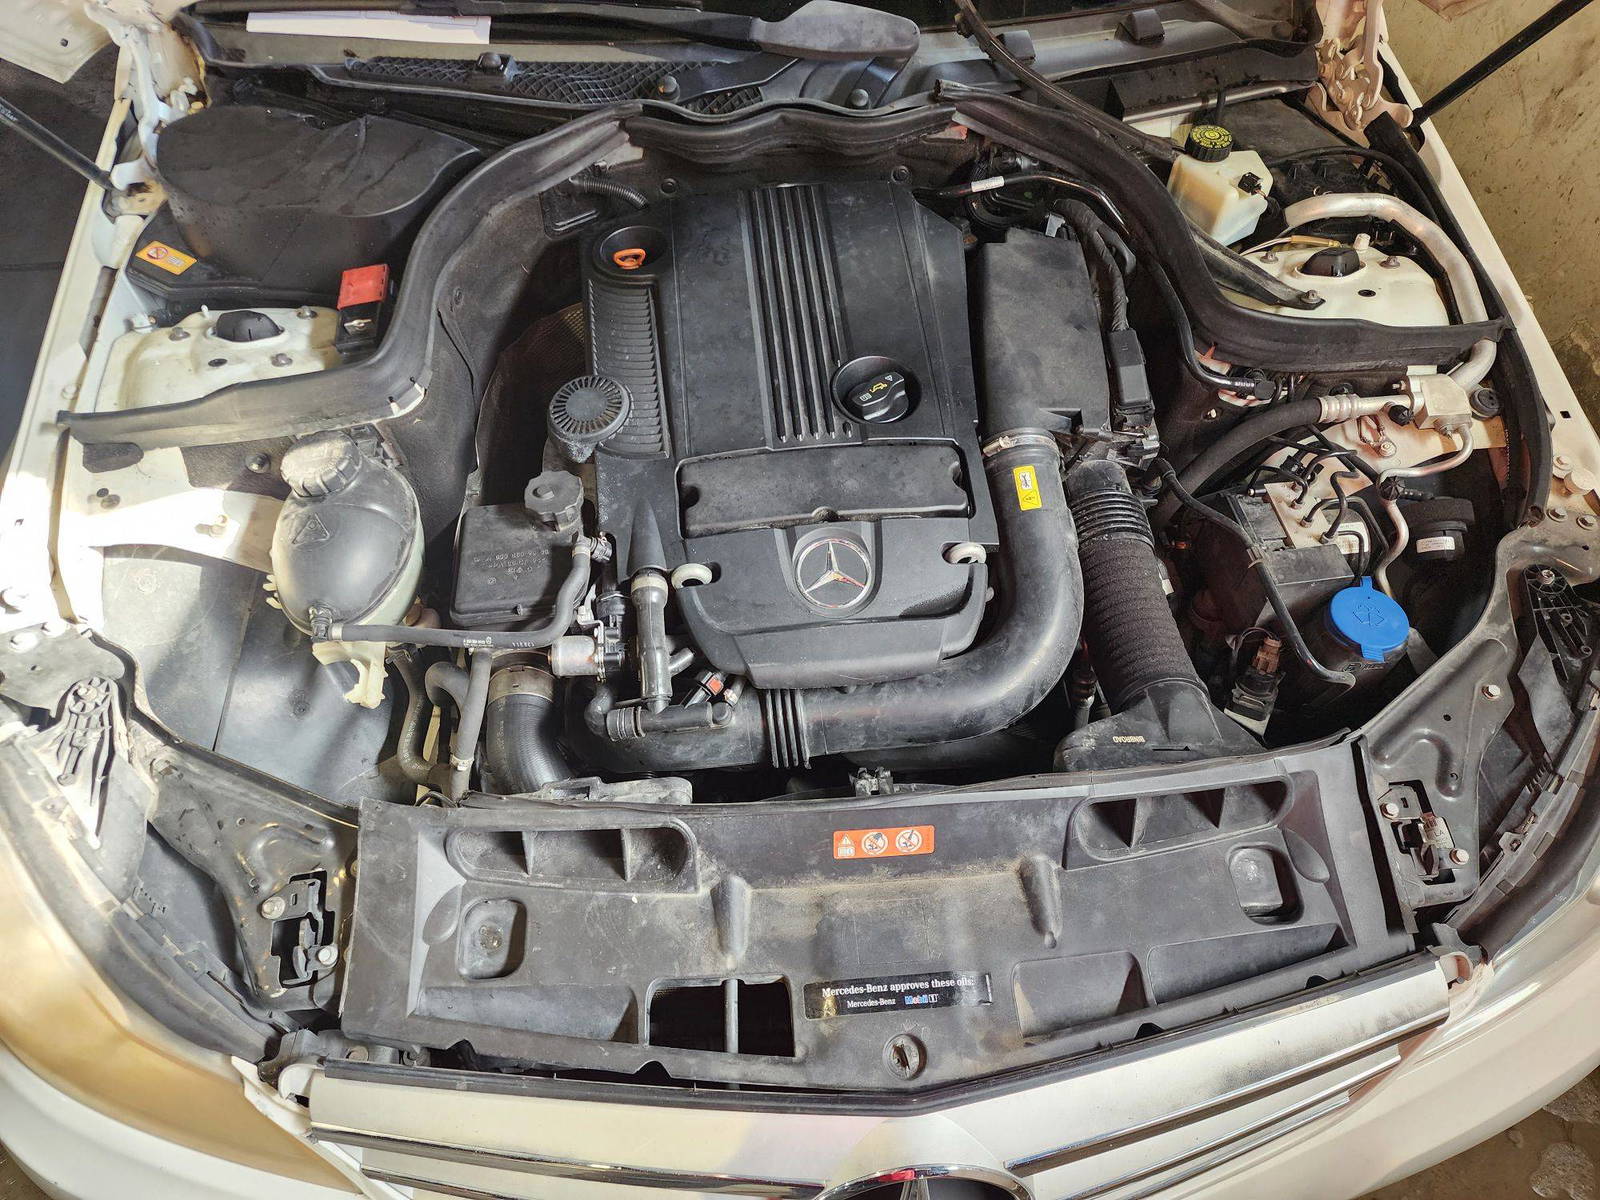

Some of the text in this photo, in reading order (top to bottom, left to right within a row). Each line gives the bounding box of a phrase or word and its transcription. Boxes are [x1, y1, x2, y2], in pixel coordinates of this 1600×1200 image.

[822, 983, 888, 998] Mercedes-Benz
[890, 980, 929, 993] approves
[931, 979, 955, 988] these
[847, 998, 896, 1008] Mercedes-Benz
[904, 994, 928, 1005] Mobil
